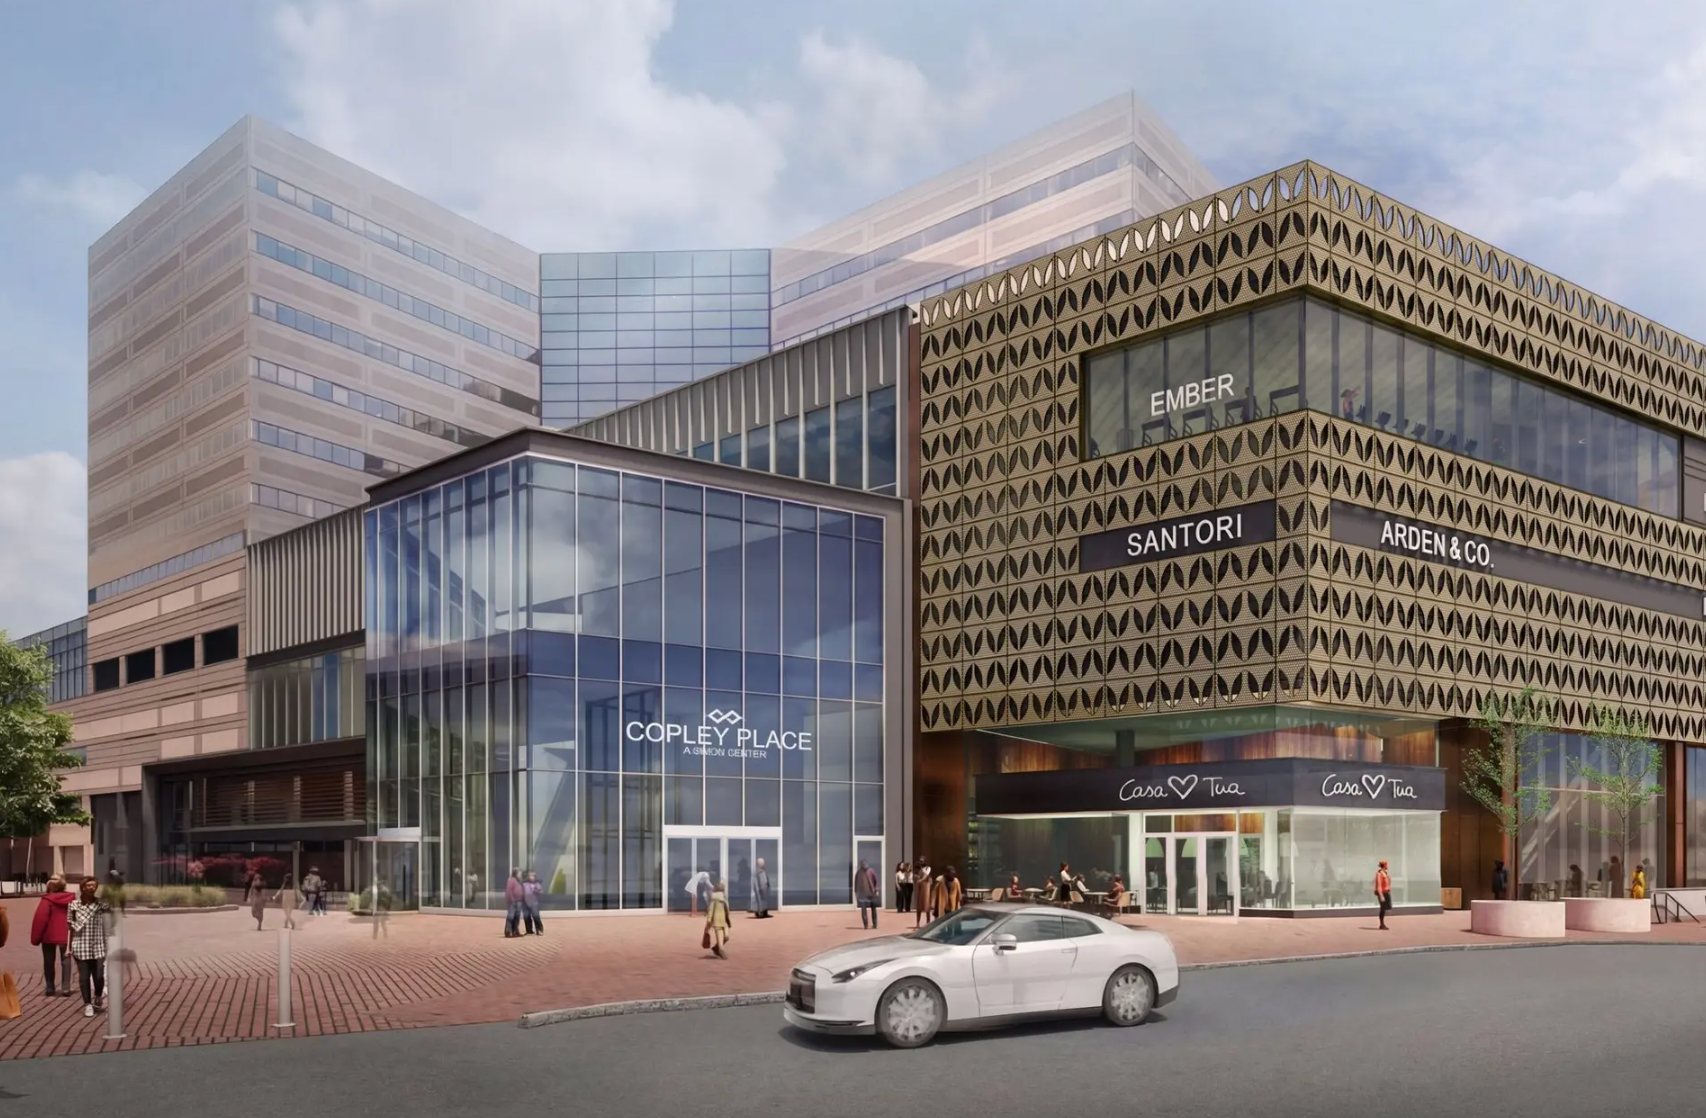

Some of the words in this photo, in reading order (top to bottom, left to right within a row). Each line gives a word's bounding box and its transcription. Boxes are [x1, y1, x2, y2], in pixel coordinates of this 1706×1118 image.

[1151, 373, 1235, 416] EMBER
[1127, 513, 1242, 556] SANTORI
[1380, 520, 1446, 557] ARDEN
[1464, 540, 1494, 568] CO.
[626, 721, 729, 746] COPLEY
[737, 728, 812, 751] PLACE
[682, 746, 691, 755] A
[693, 746, 725, 757] SIMON
[727, 748, 767, 759] CENTER
[1119, 778, 1168, 801] Casa
[1203, 776, 1245, 796] Tua
[1321, 773, 1362, 797] Casa
[1388, 778, 1417, 799] Tua
